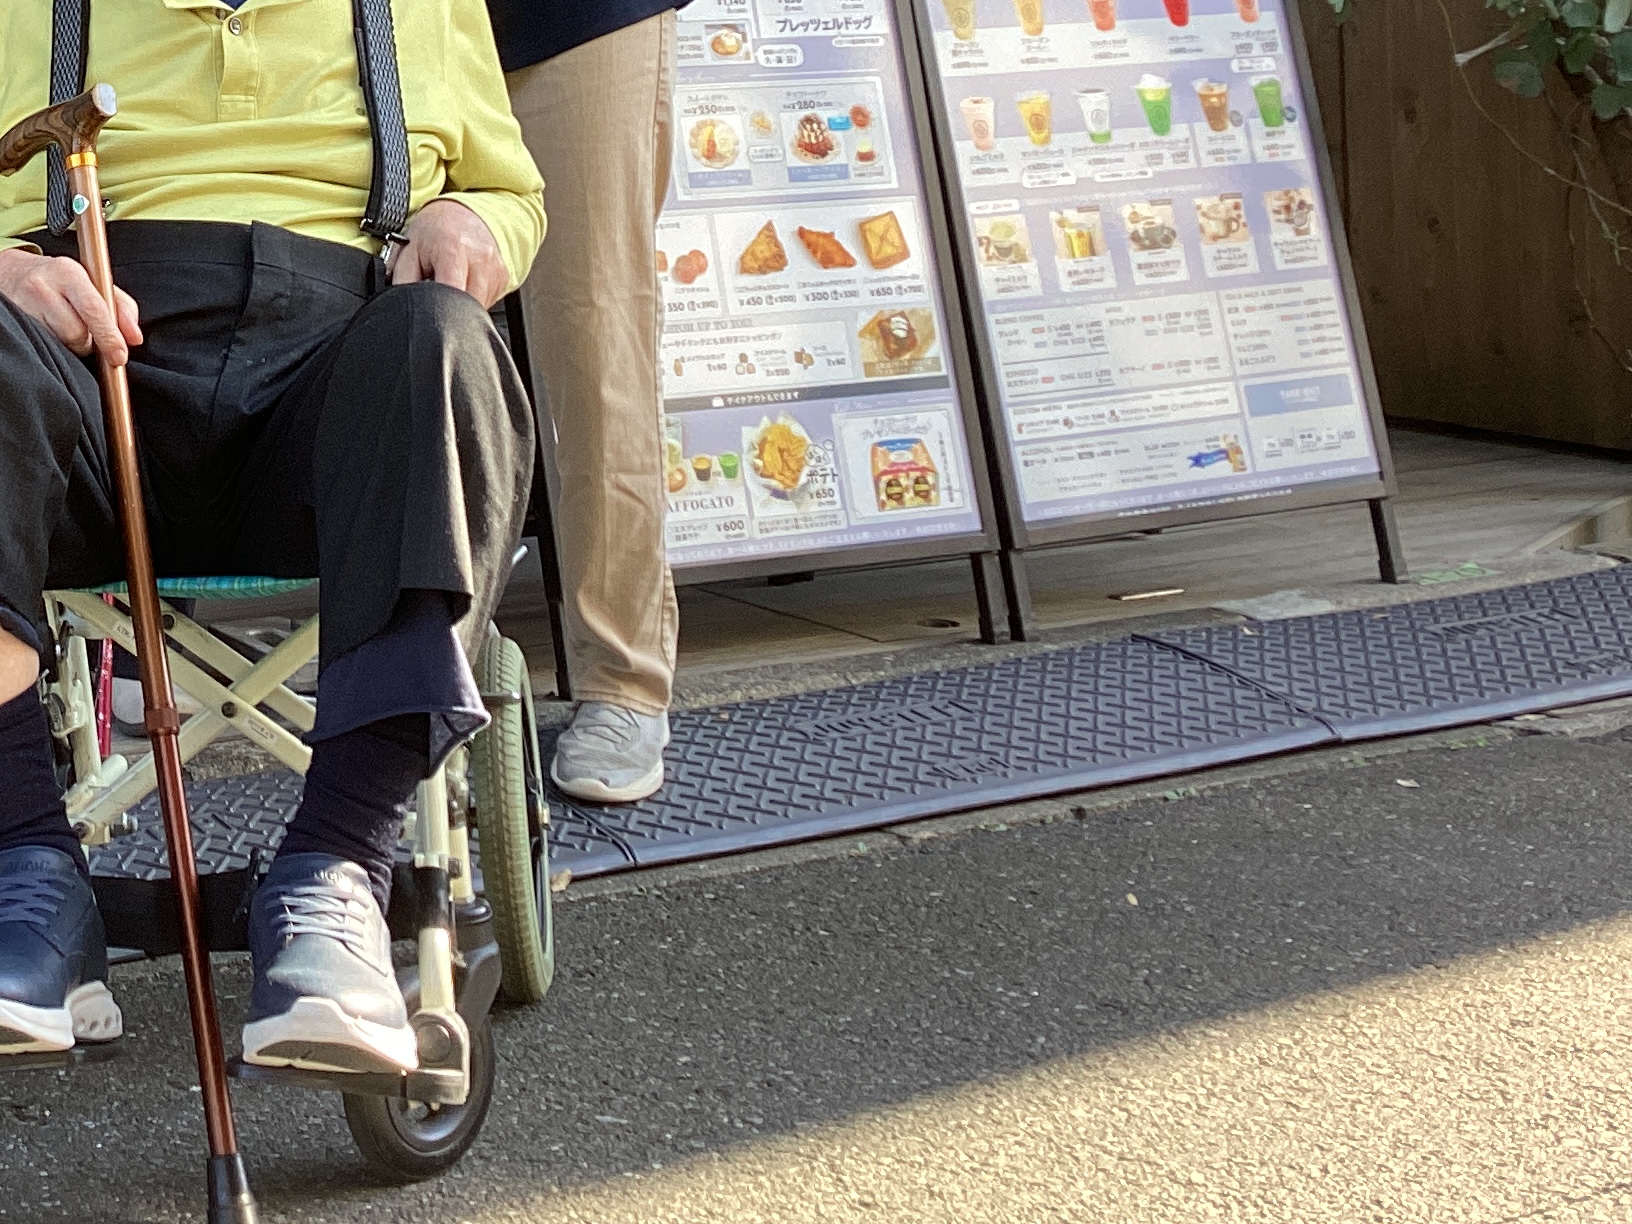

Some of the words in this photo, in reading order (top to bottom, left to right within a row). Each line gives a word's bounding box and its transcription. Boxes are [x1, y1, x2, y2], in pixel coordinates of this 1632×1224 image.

[776, 16, 873, 33] プレッツェルドッグ
[807, 467, 839, 485] ポテト
